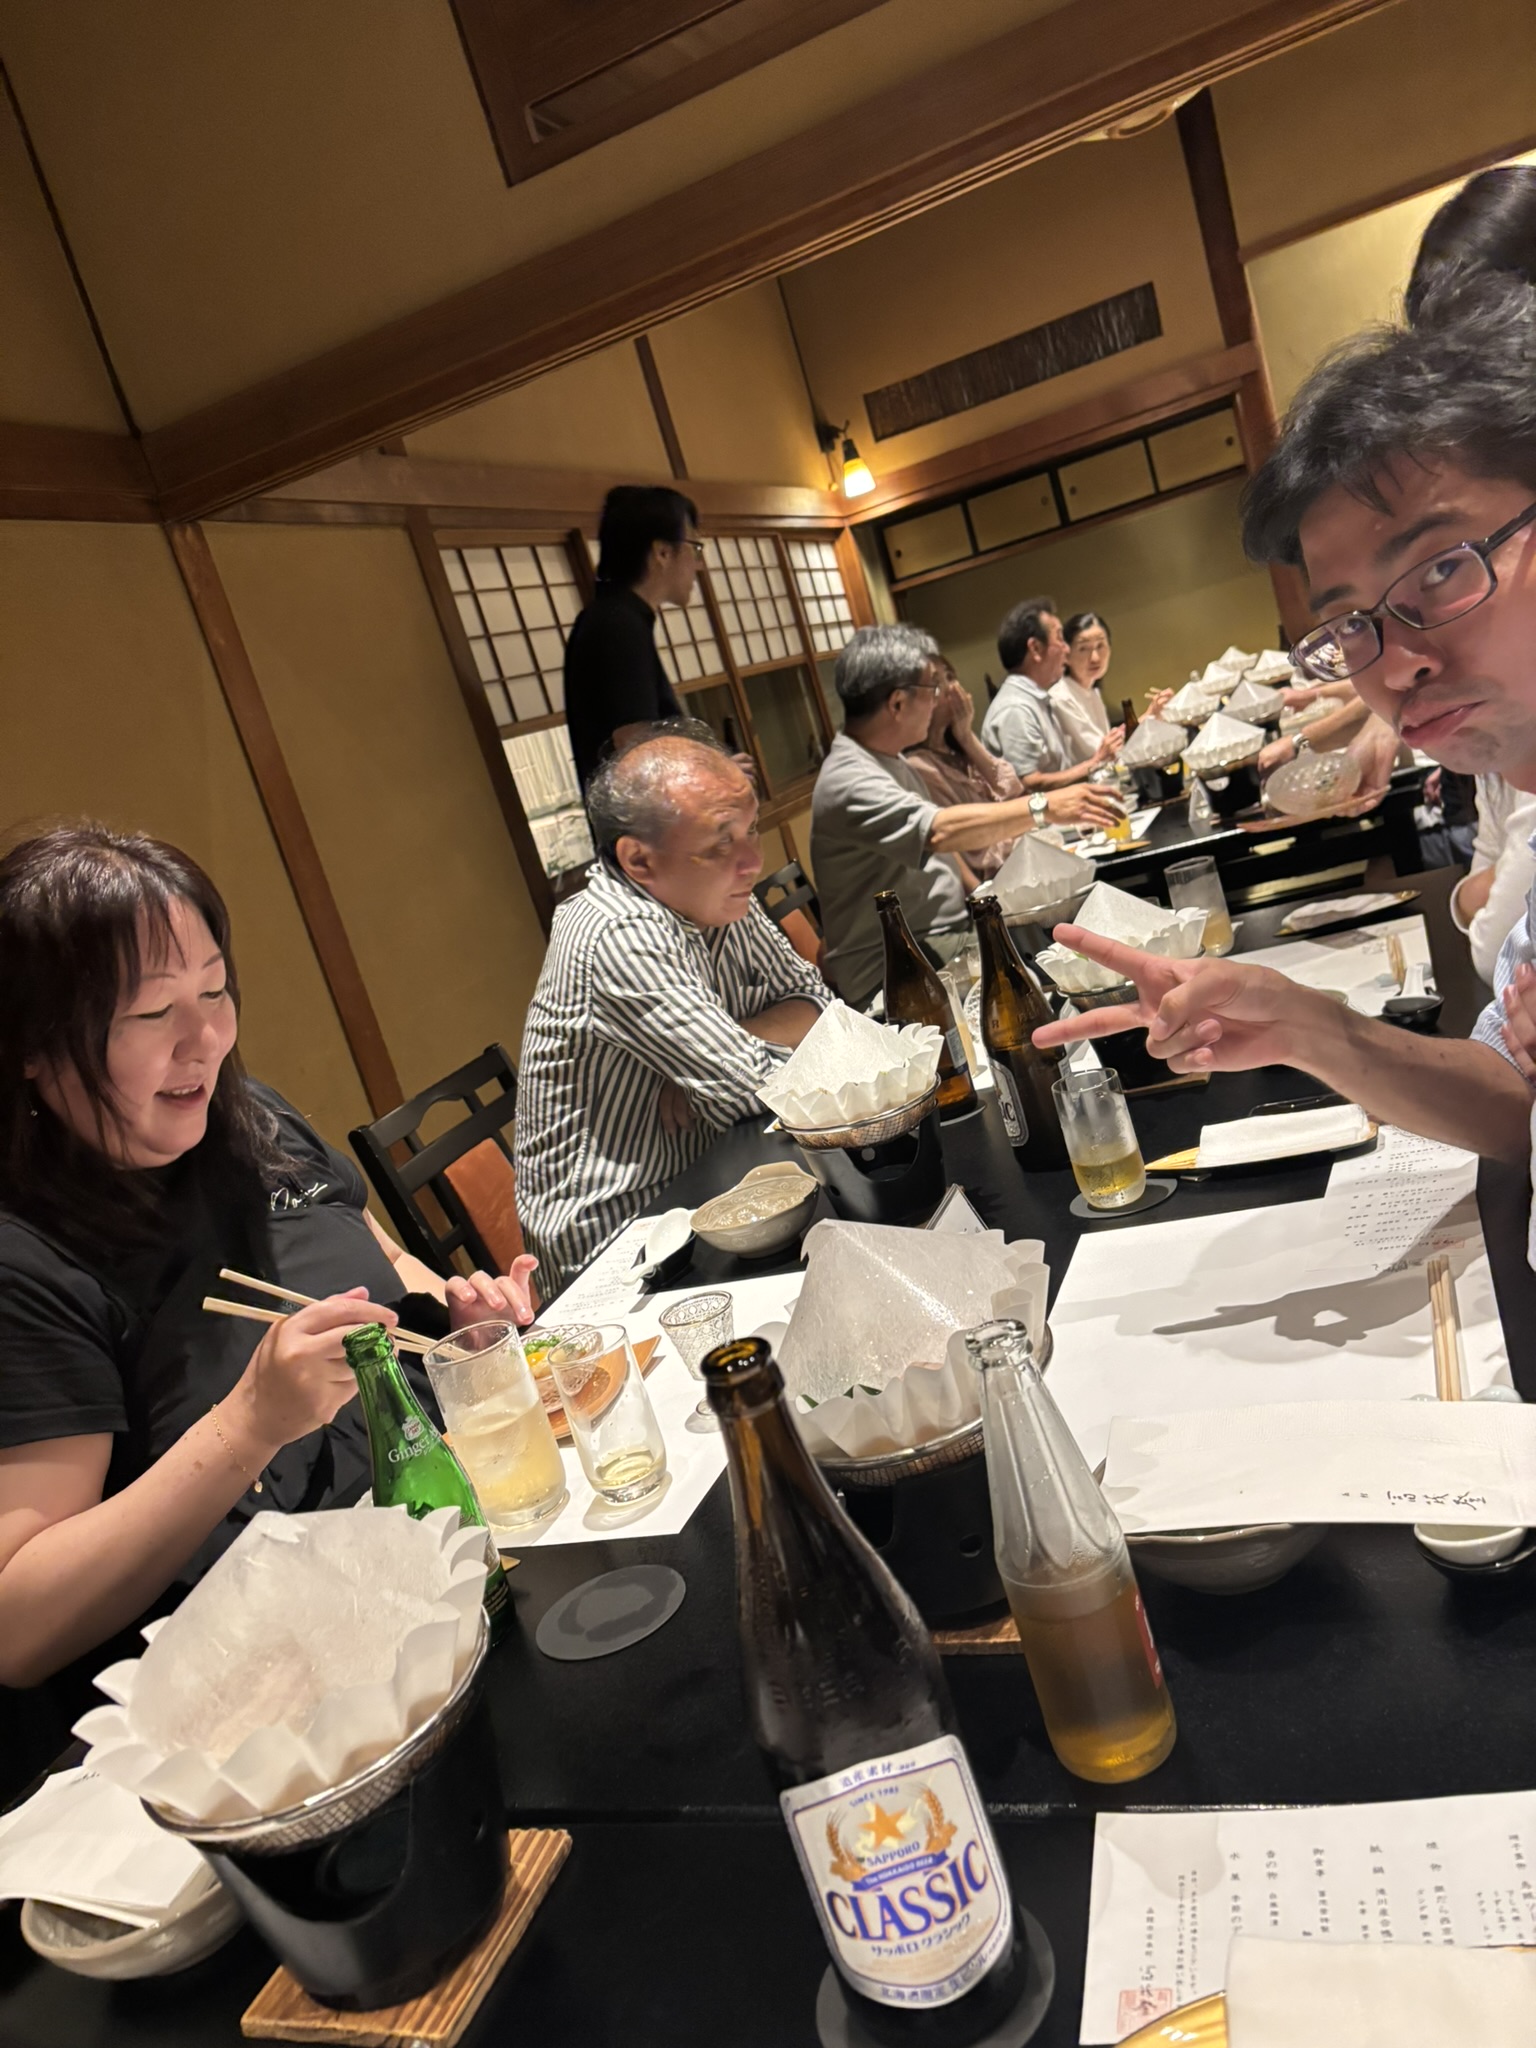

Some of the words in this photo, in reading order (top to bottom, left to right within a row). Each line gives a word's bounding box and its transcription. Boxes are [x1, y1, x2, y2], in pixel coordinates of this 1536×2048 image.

[388, 1435, 430, 1463] Ginger
[866, 1841, 921, 1867] SAPPORO
[825, 1840, 989, 1941] CLASSIC
